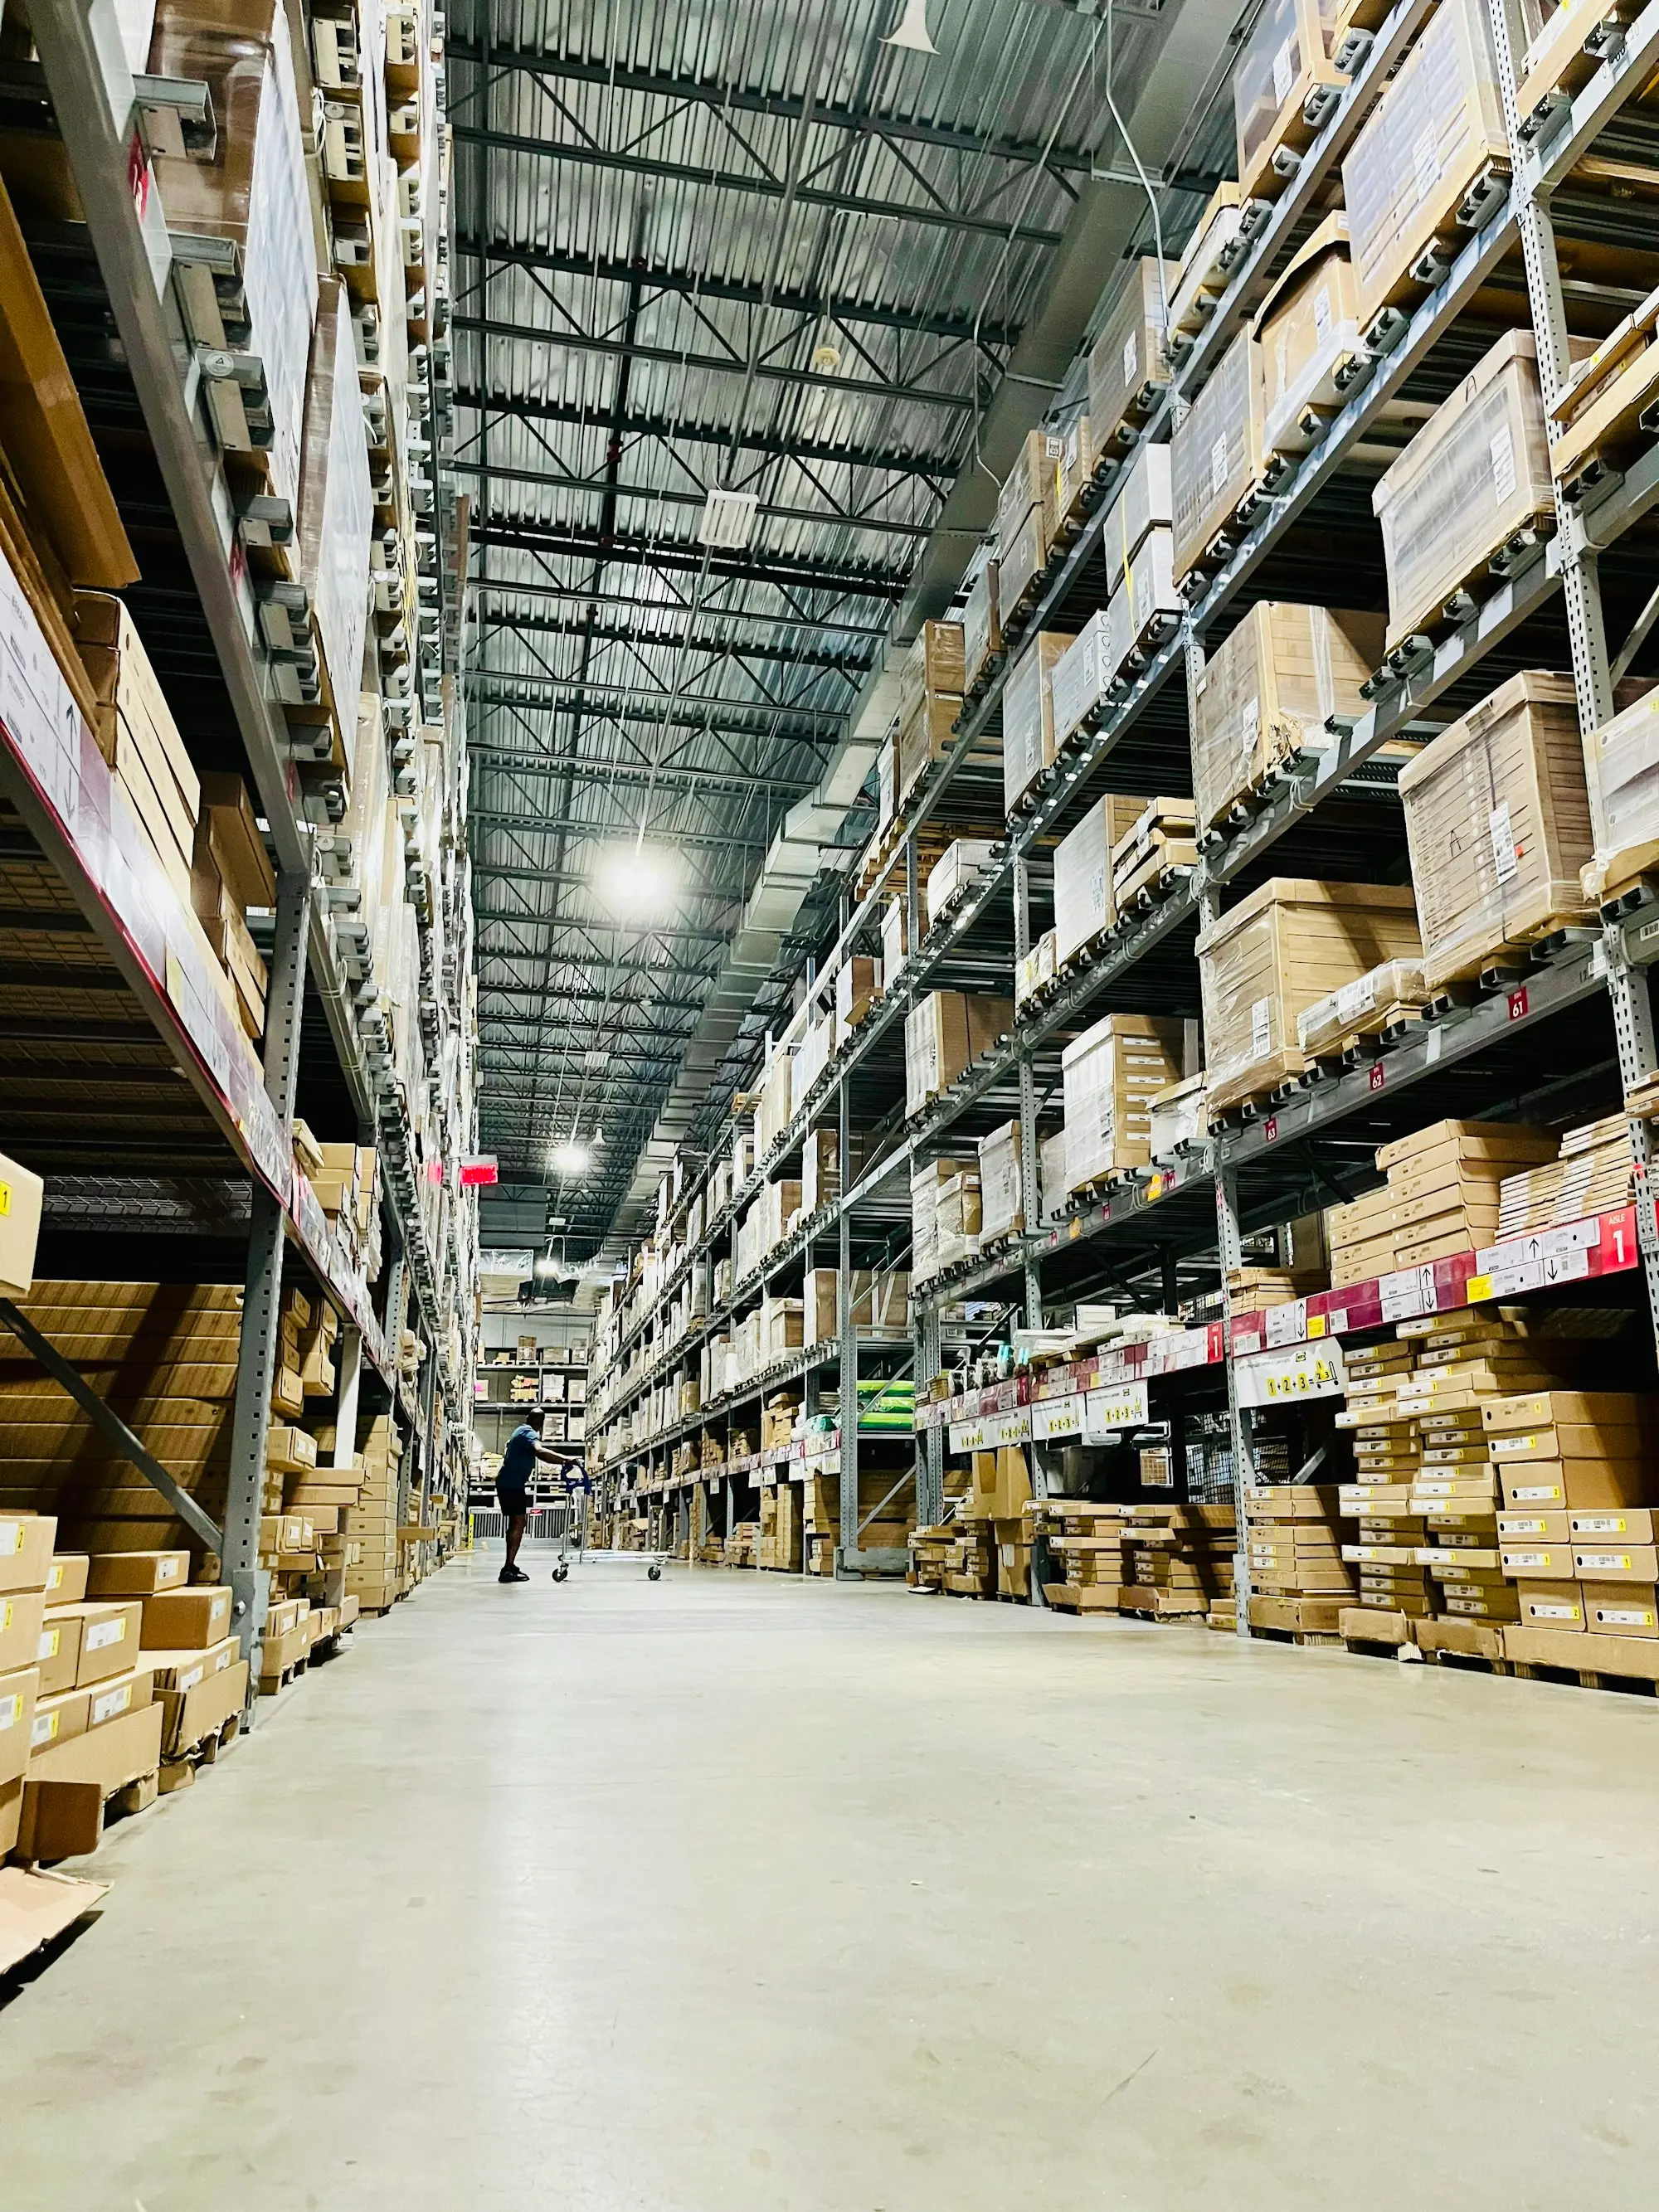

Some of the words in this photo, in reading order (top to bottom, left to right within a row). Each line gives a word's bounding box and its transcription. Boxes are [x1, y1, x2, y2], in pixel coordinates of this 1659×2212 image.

[1465, 375, 1477, 403] A
[1449, 829, 1462, 857] A
[1512, 1004, 1524, 1018] 61
[1372, 1075, 1382, 1089] 62
[1267, 1128, 1276, 1140] 63
[3, 1190, 7, 1208] 1
[1608, 1213, 1627, 1226] AISLE
[1612, 1229, 1624, 1263] 1
[1214, 1336, 1219, 1358] 1
[1284, 1379, 1290, 1391] 2
[1300, 1377, 1306, 1388] 3
